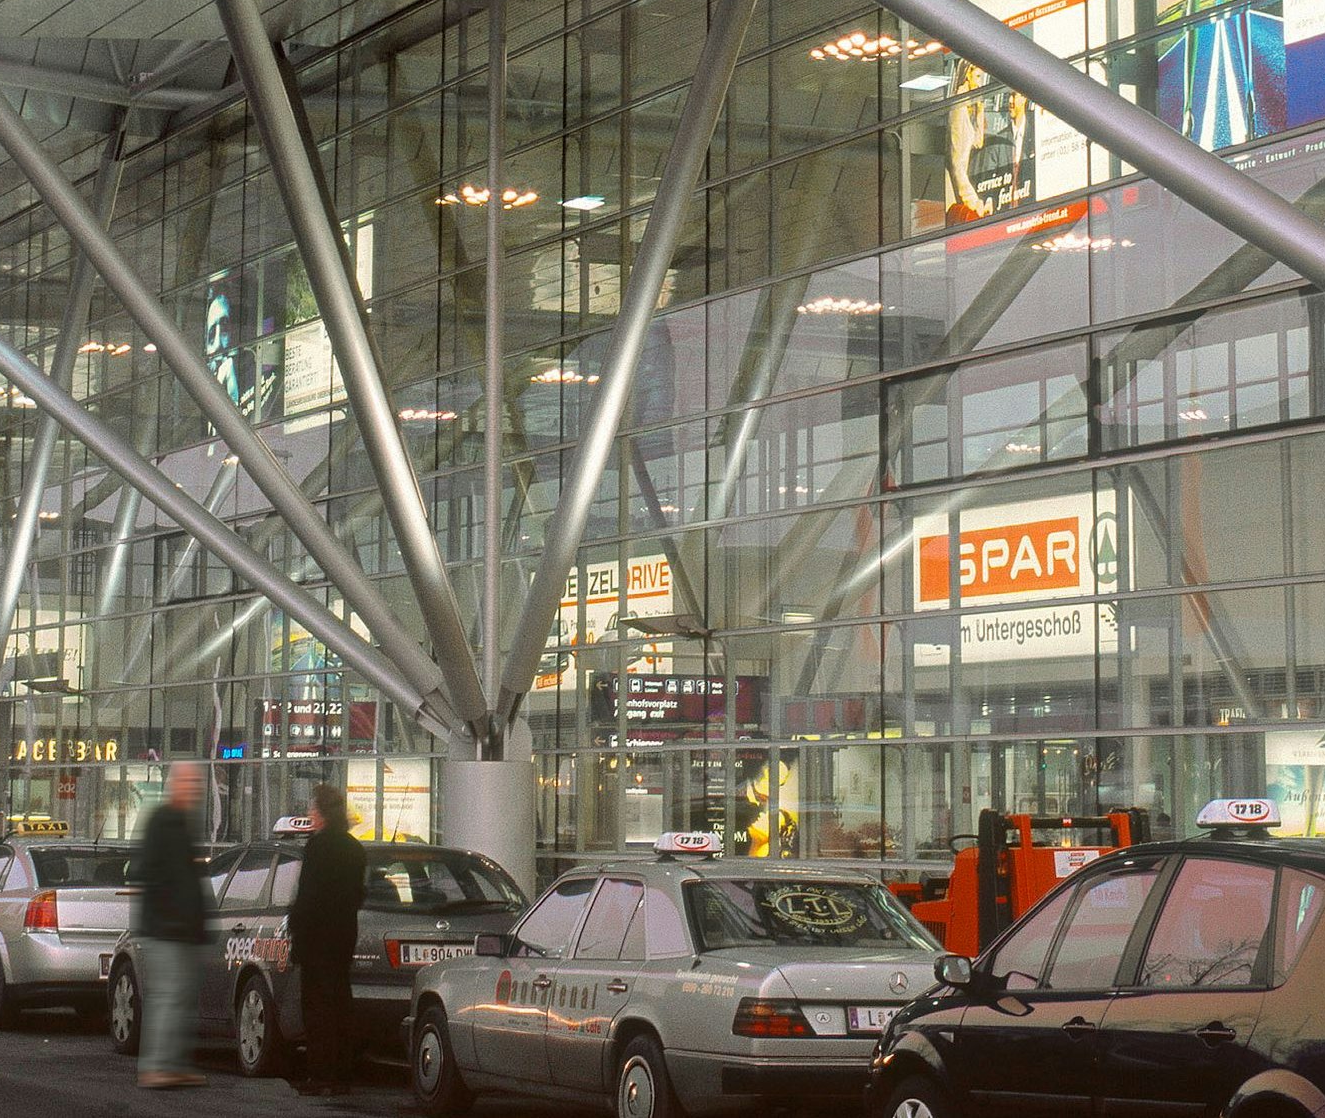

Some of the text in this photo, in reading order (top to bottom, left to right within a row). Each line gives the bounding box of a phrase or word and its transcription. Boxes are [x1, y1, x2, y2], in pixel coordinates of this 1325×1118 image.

[1265, 149, 1296, 164] Entwurf
[977, 172, 1013, 193] service to
[997, 179, 1031, 211] feel well
[960, 530, 1076, 586] SPAR
[976, 610, 1081, 645] Untergeschoß
[293, 704, 312, 715] und
[30, 823, 64, 831] TAXI
